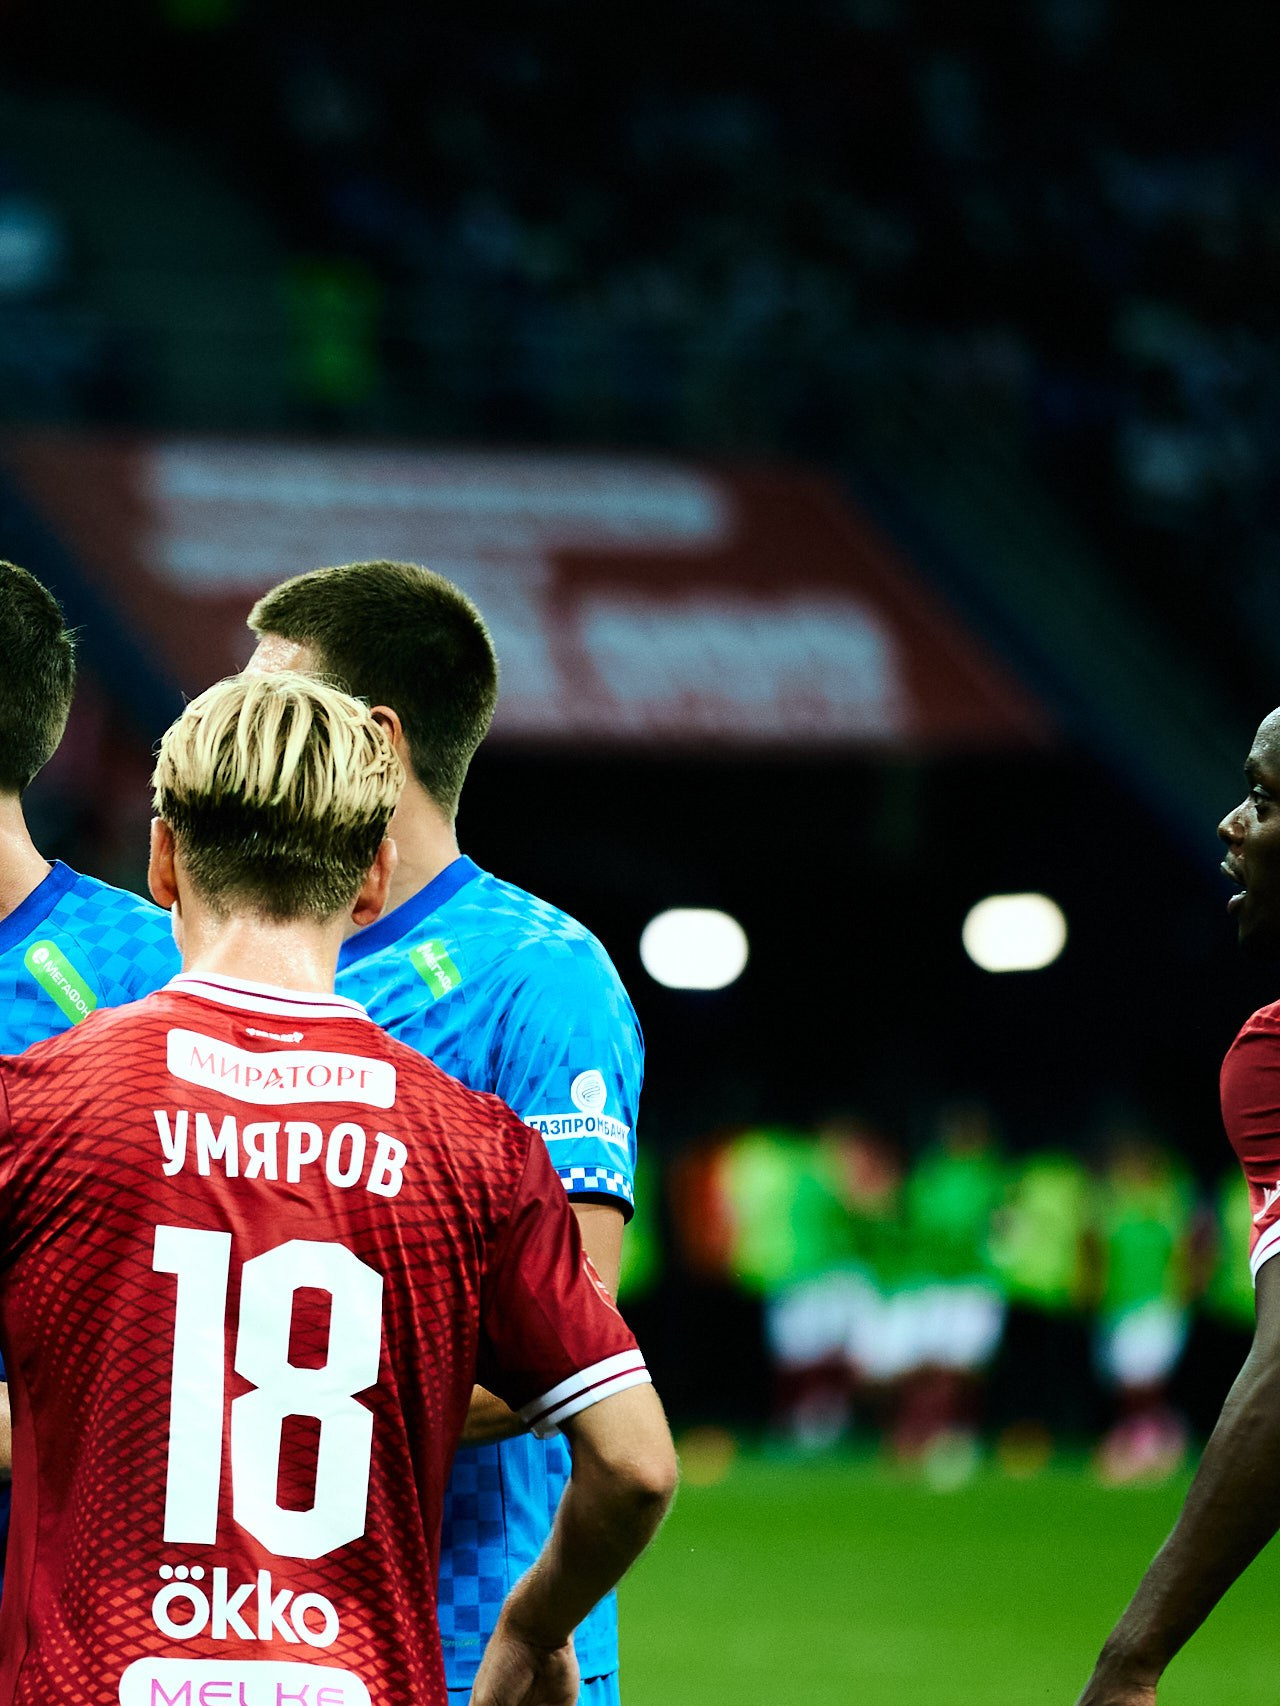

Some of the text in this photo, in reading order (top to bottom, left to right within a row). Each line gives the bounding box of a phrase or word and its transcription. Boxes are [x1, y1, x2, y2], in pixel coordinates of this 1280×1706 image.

[43, 960, 92, 1019] МЕГАФОН
[190, 1046, 373, 1090] МИРАТОРГ
[153, 1109, 408, 1198] УМЯРОВ
[152, 1224, 384, 1560] 18
